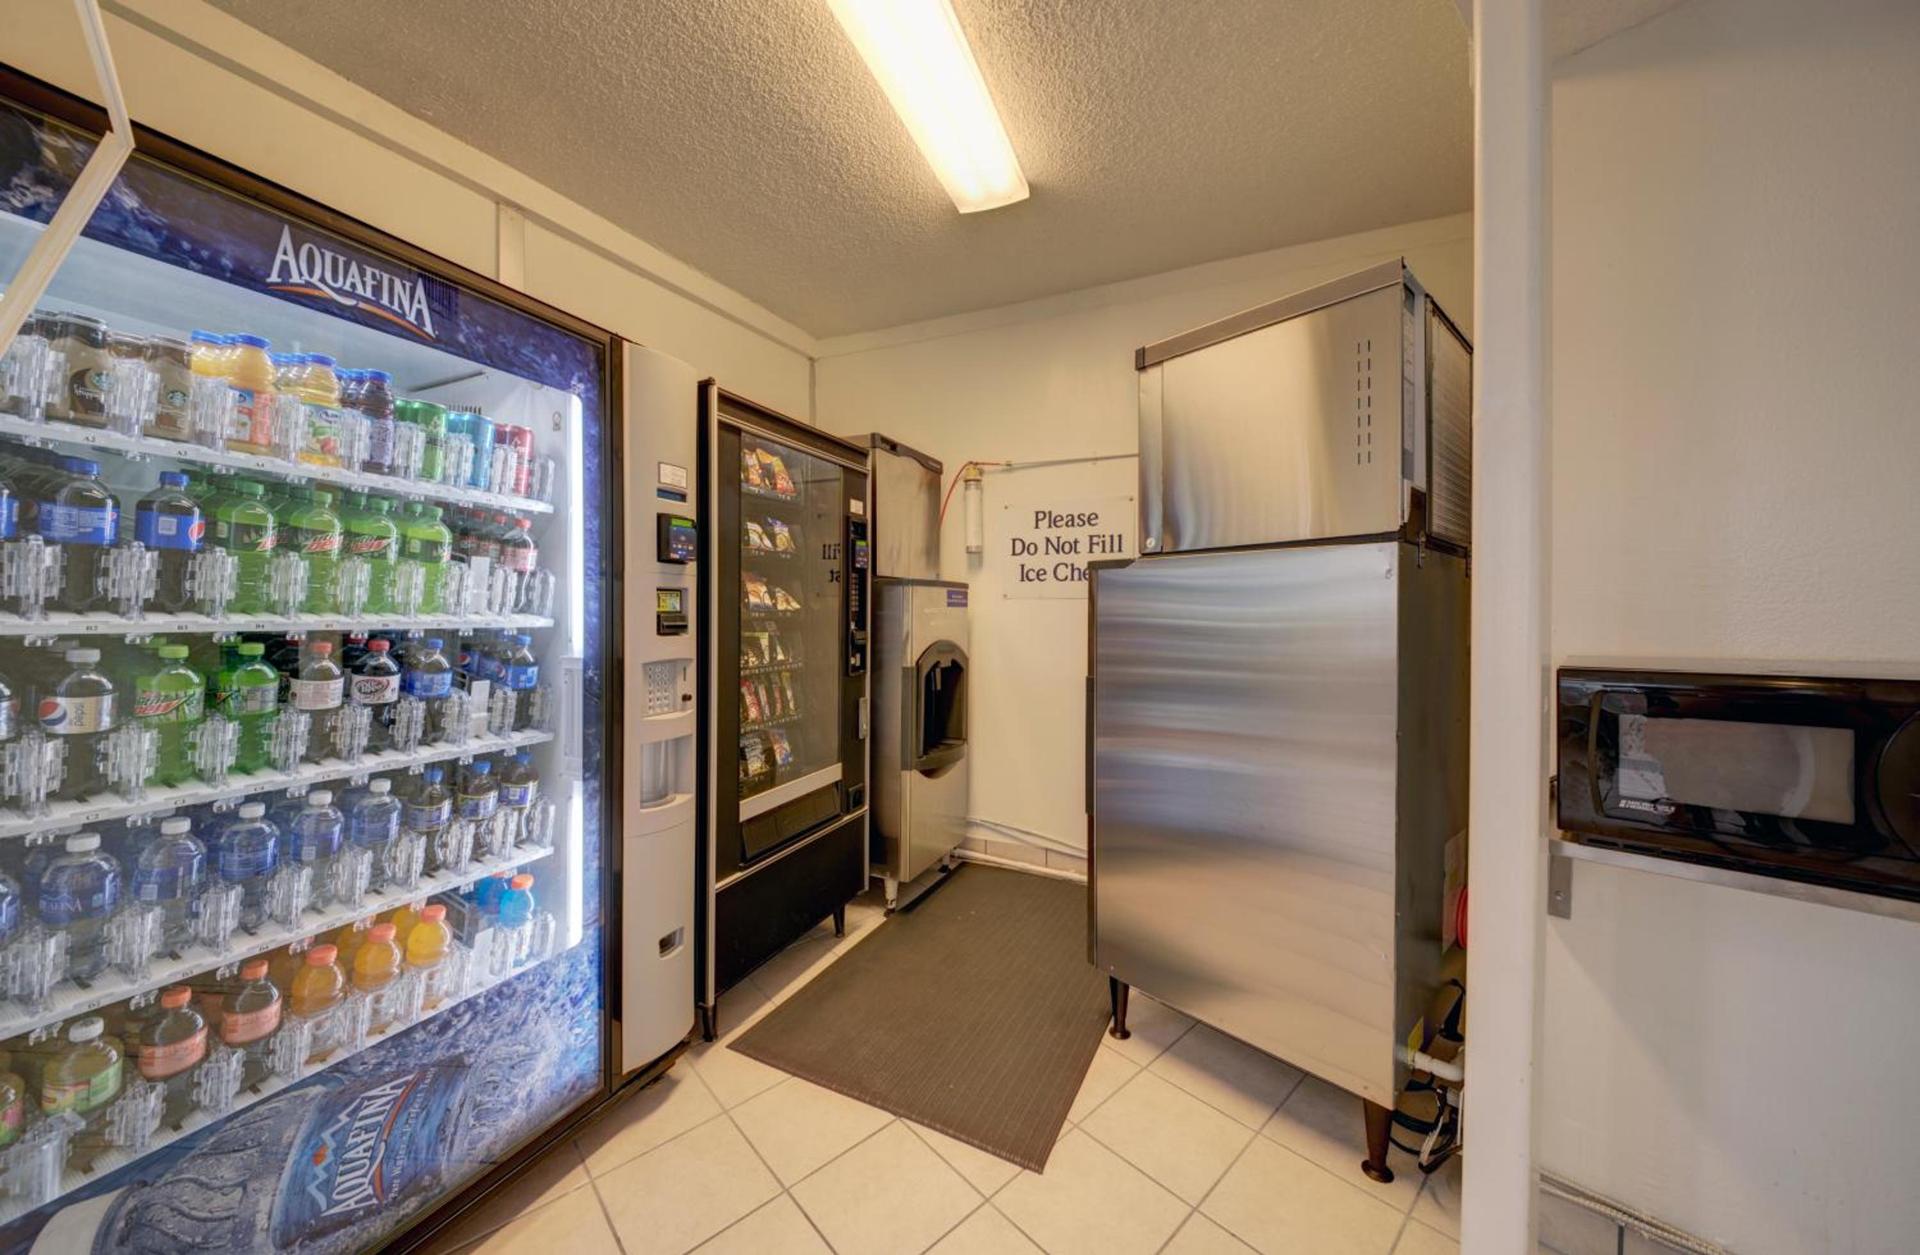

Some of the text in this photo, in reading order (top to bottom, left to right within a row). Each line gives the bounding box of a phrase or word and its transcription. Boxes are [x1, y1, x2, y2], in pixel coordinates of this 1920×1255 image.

[266, 224, 437, 338] AQUAFINA
[1034, 510, 1099, 529] Please
[1011, 534, 1124, 556] Do Not Fill
[1019, 562, 1089, 582] Ice Che
[320, 1072, 416, 1218] AQUAFINA
